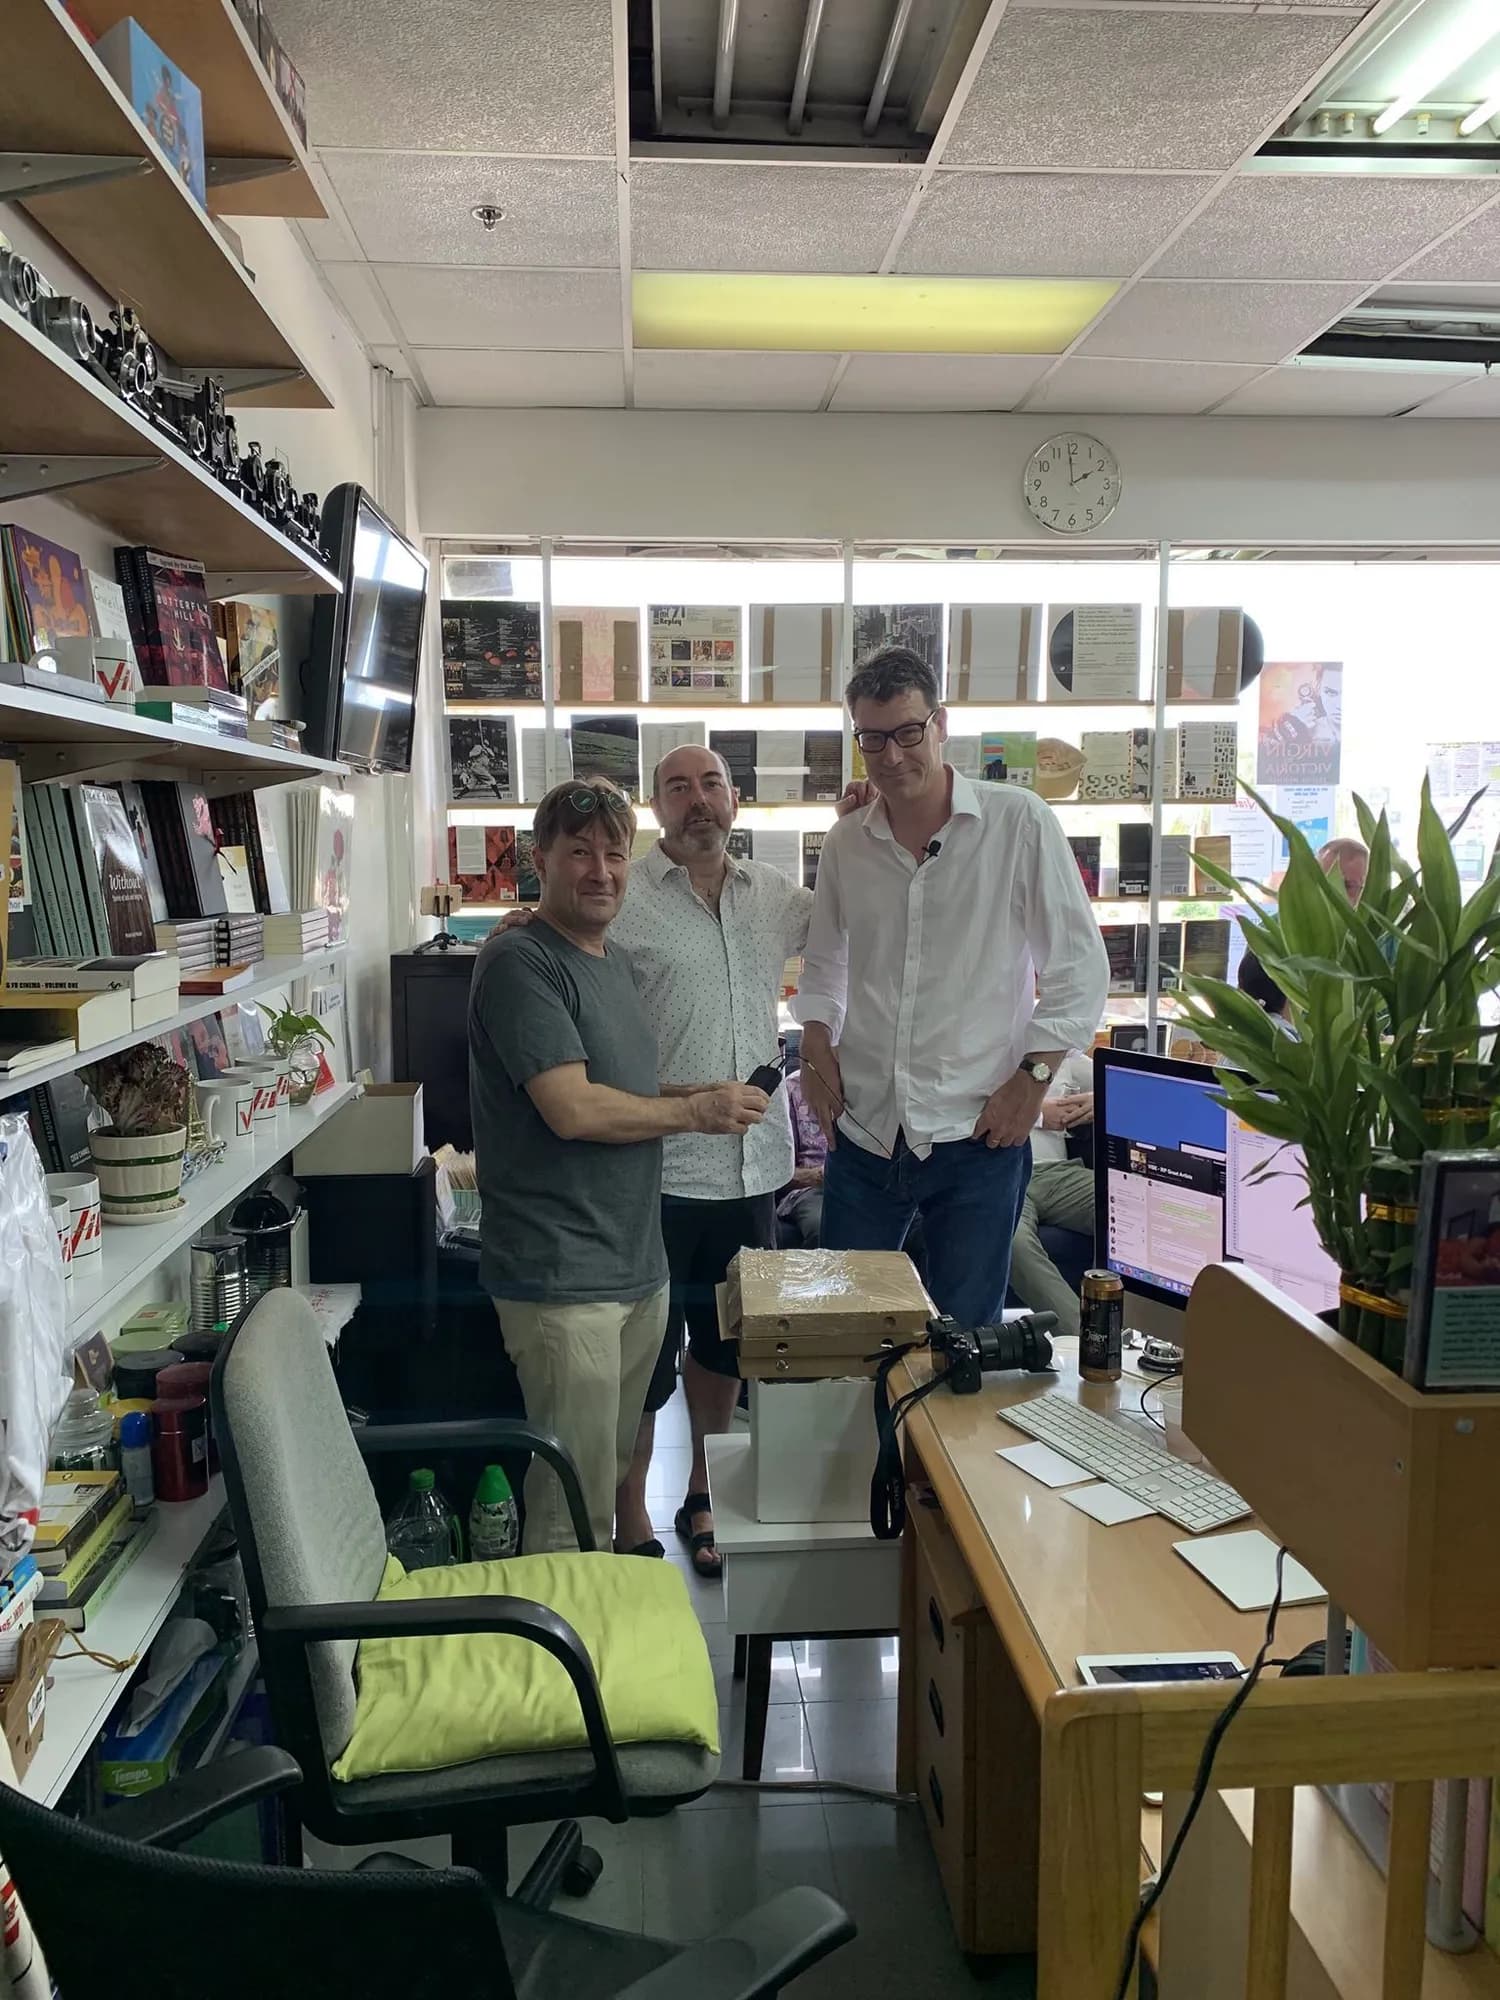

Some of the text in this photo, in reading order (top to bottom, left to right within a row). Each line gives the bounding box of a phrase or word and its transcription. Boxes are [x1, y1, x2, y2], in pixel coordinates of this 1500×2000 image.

[1052, 447, 1061, 459] 11
[1039, 460, 1050, 472] 10
[1097, 459, 1105, 472] 2
[1033, 479, 1042, 491] 9
[1103, 478, 1111, 490] 3
[1039, 496, 1048, 508] 8
[1096, 495, 1105, 506] 4
[1051, 509, 1060, 521] 7
[1067, 513, 1077, 526] 6
[1085, 508, 1094, 521] 5
[156, 594, 208, 613] BUTTERFLY
[174, 610, 194, 622] HILL
[108, 872, 141, 891] Without
[19, 981, 40, 989] CINEMA
[44, 981, 66, 989] VOLUME
[111, 1767, 149, 1785] Tempo
